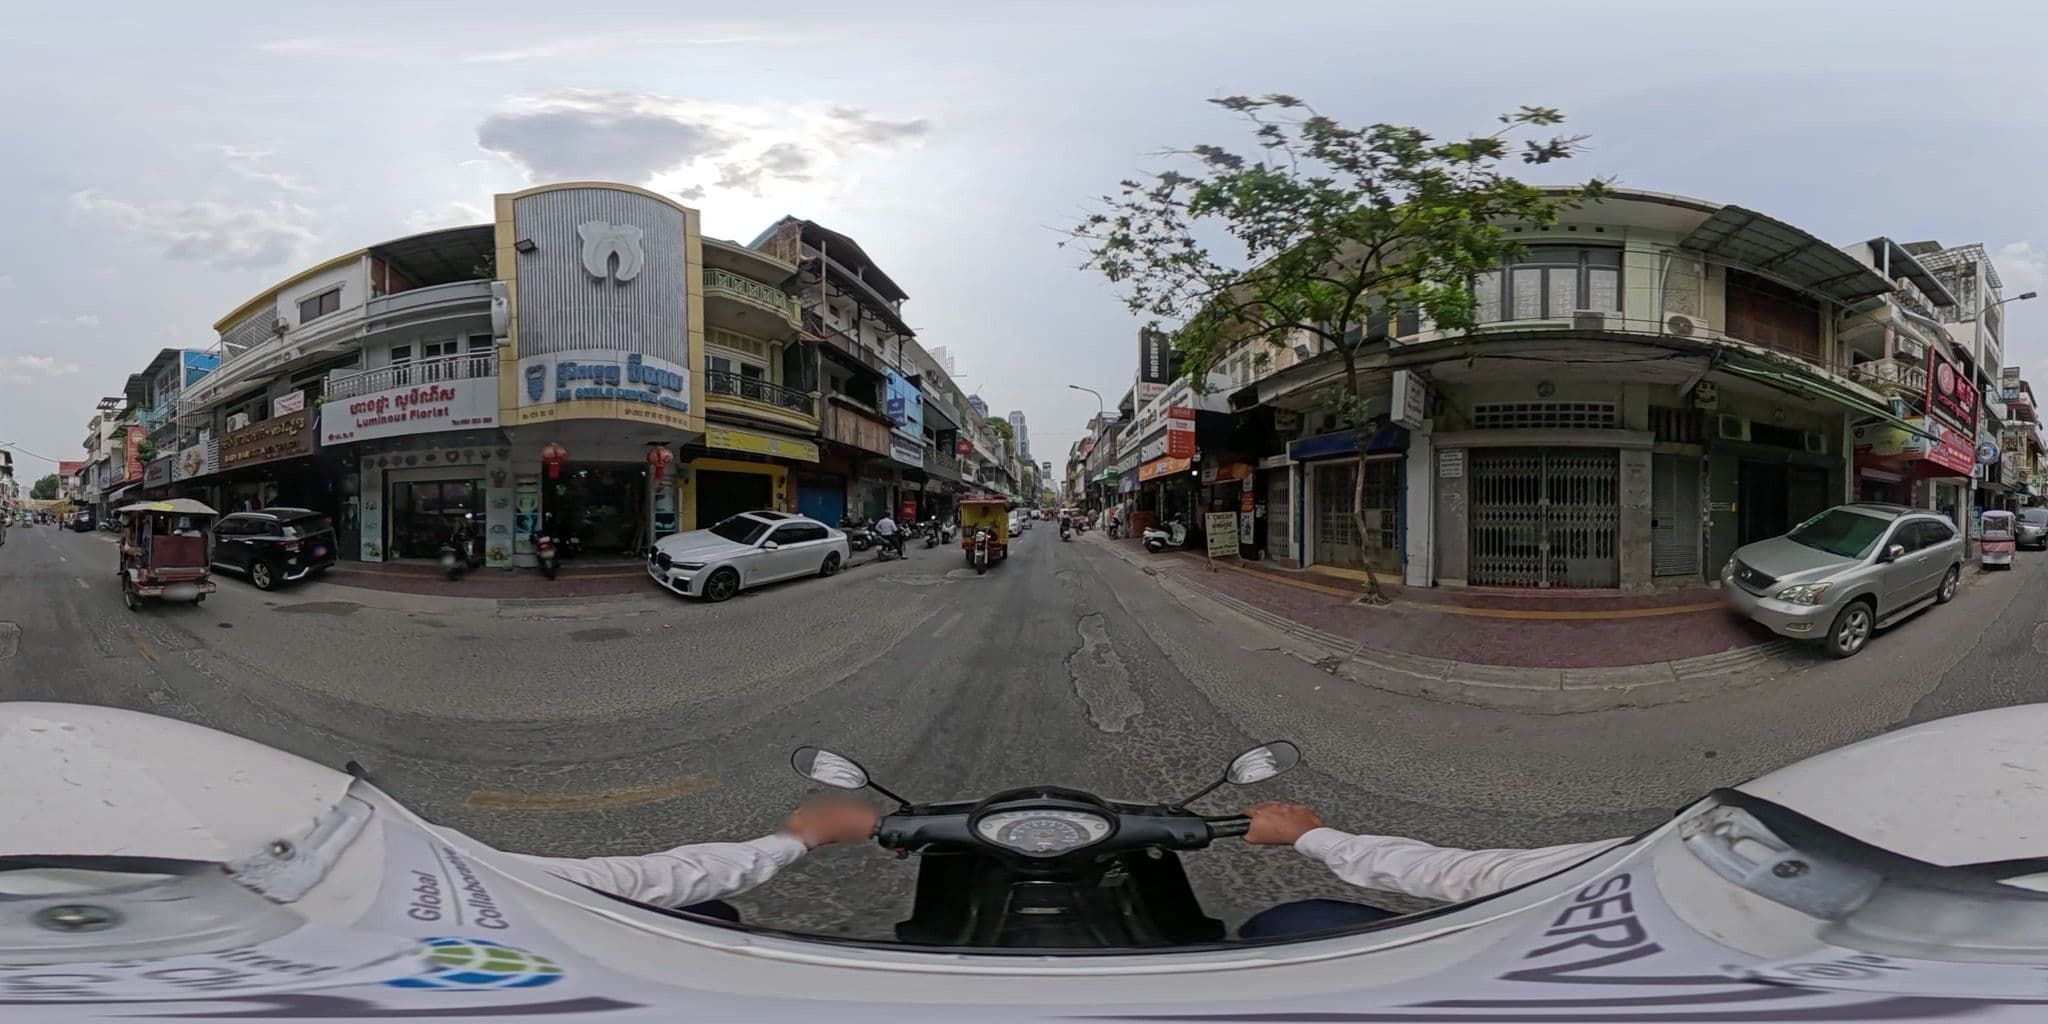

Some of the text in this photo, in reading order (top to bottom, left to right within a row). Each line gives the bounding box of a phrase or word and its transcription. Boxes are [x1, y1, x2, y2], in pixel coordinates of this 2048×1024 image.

[1150, 336, 1159, 378] SAMSUNG
[575, 387, 614, 400] SMILE
[356, 406, 449, 428] Luminous Florist
[407, 869, 442, 922] Global
